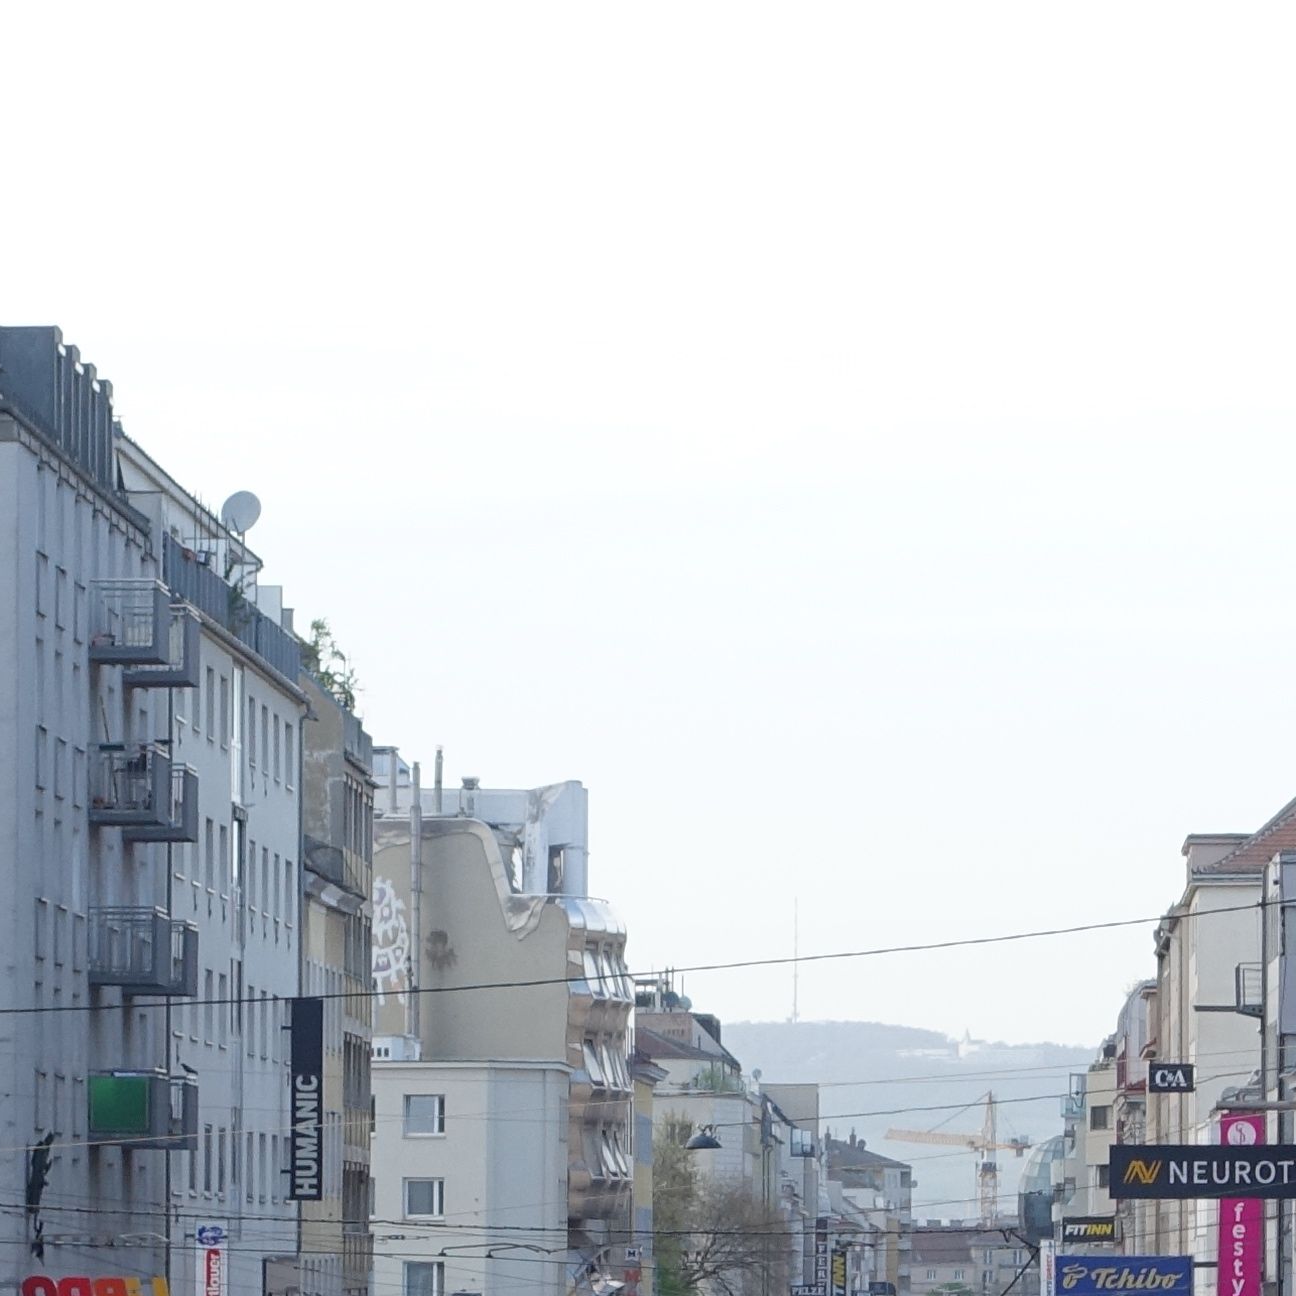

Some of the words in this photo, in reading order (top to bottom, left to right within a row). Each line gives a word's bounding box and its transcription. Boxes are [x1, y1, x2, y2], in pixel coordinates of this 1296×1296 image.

[1155, 1069, 1187, 1087] C&A
[295, 1074, 319, 1196] HUMANIC
[1065, 1223, 1113, 1236] FITINN
[1090, 1267, 1184, 1290] Tchibo
